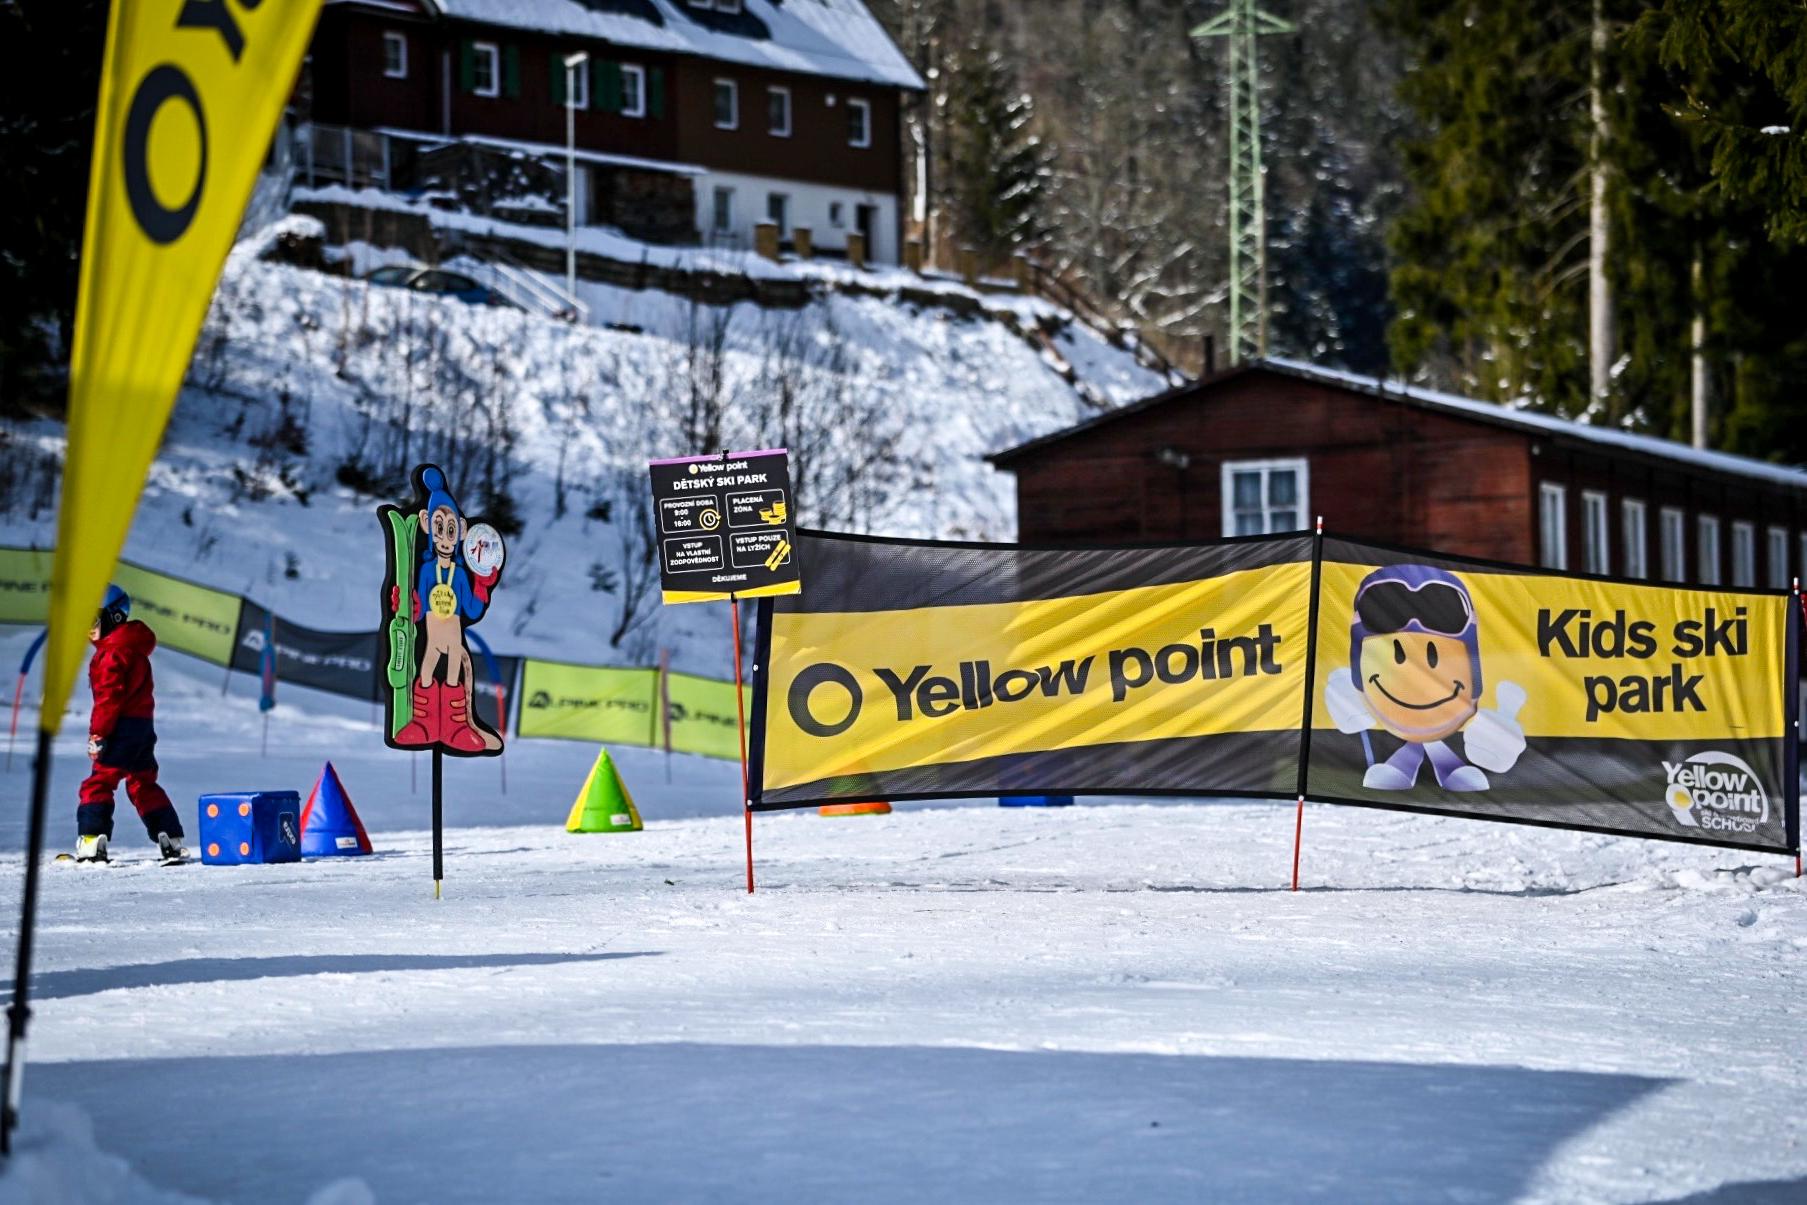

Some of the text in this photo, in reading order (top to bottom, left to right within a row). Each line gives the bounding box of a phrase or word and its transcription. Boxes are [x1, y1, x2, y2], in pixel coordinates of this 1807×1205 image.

[698, 461, 748, 473] Yellow point
[673, 473, 768, 491] DĚTSKÝ SKI PARK
[663, 499, 714, 509] PROVOZNÍ DOBA
[732, 495, 764, 505] PLACENÁ
[682, 541, 703, 549] VSTUP
[735, 534, 781, 545] VSTUP POUZE
[686, 548, 711, 556] VLASTNÍ
[747, 543, 771, 552] LYŽÍCH
[1537, 606, 1748, 660] Kids ski
[872, 623, 1283, 722] Yellow point
[1584, 663, 1708, 723] park
[1661, 761, 1748, 792] Yellow
[1692, 788, 1762, 813] point
